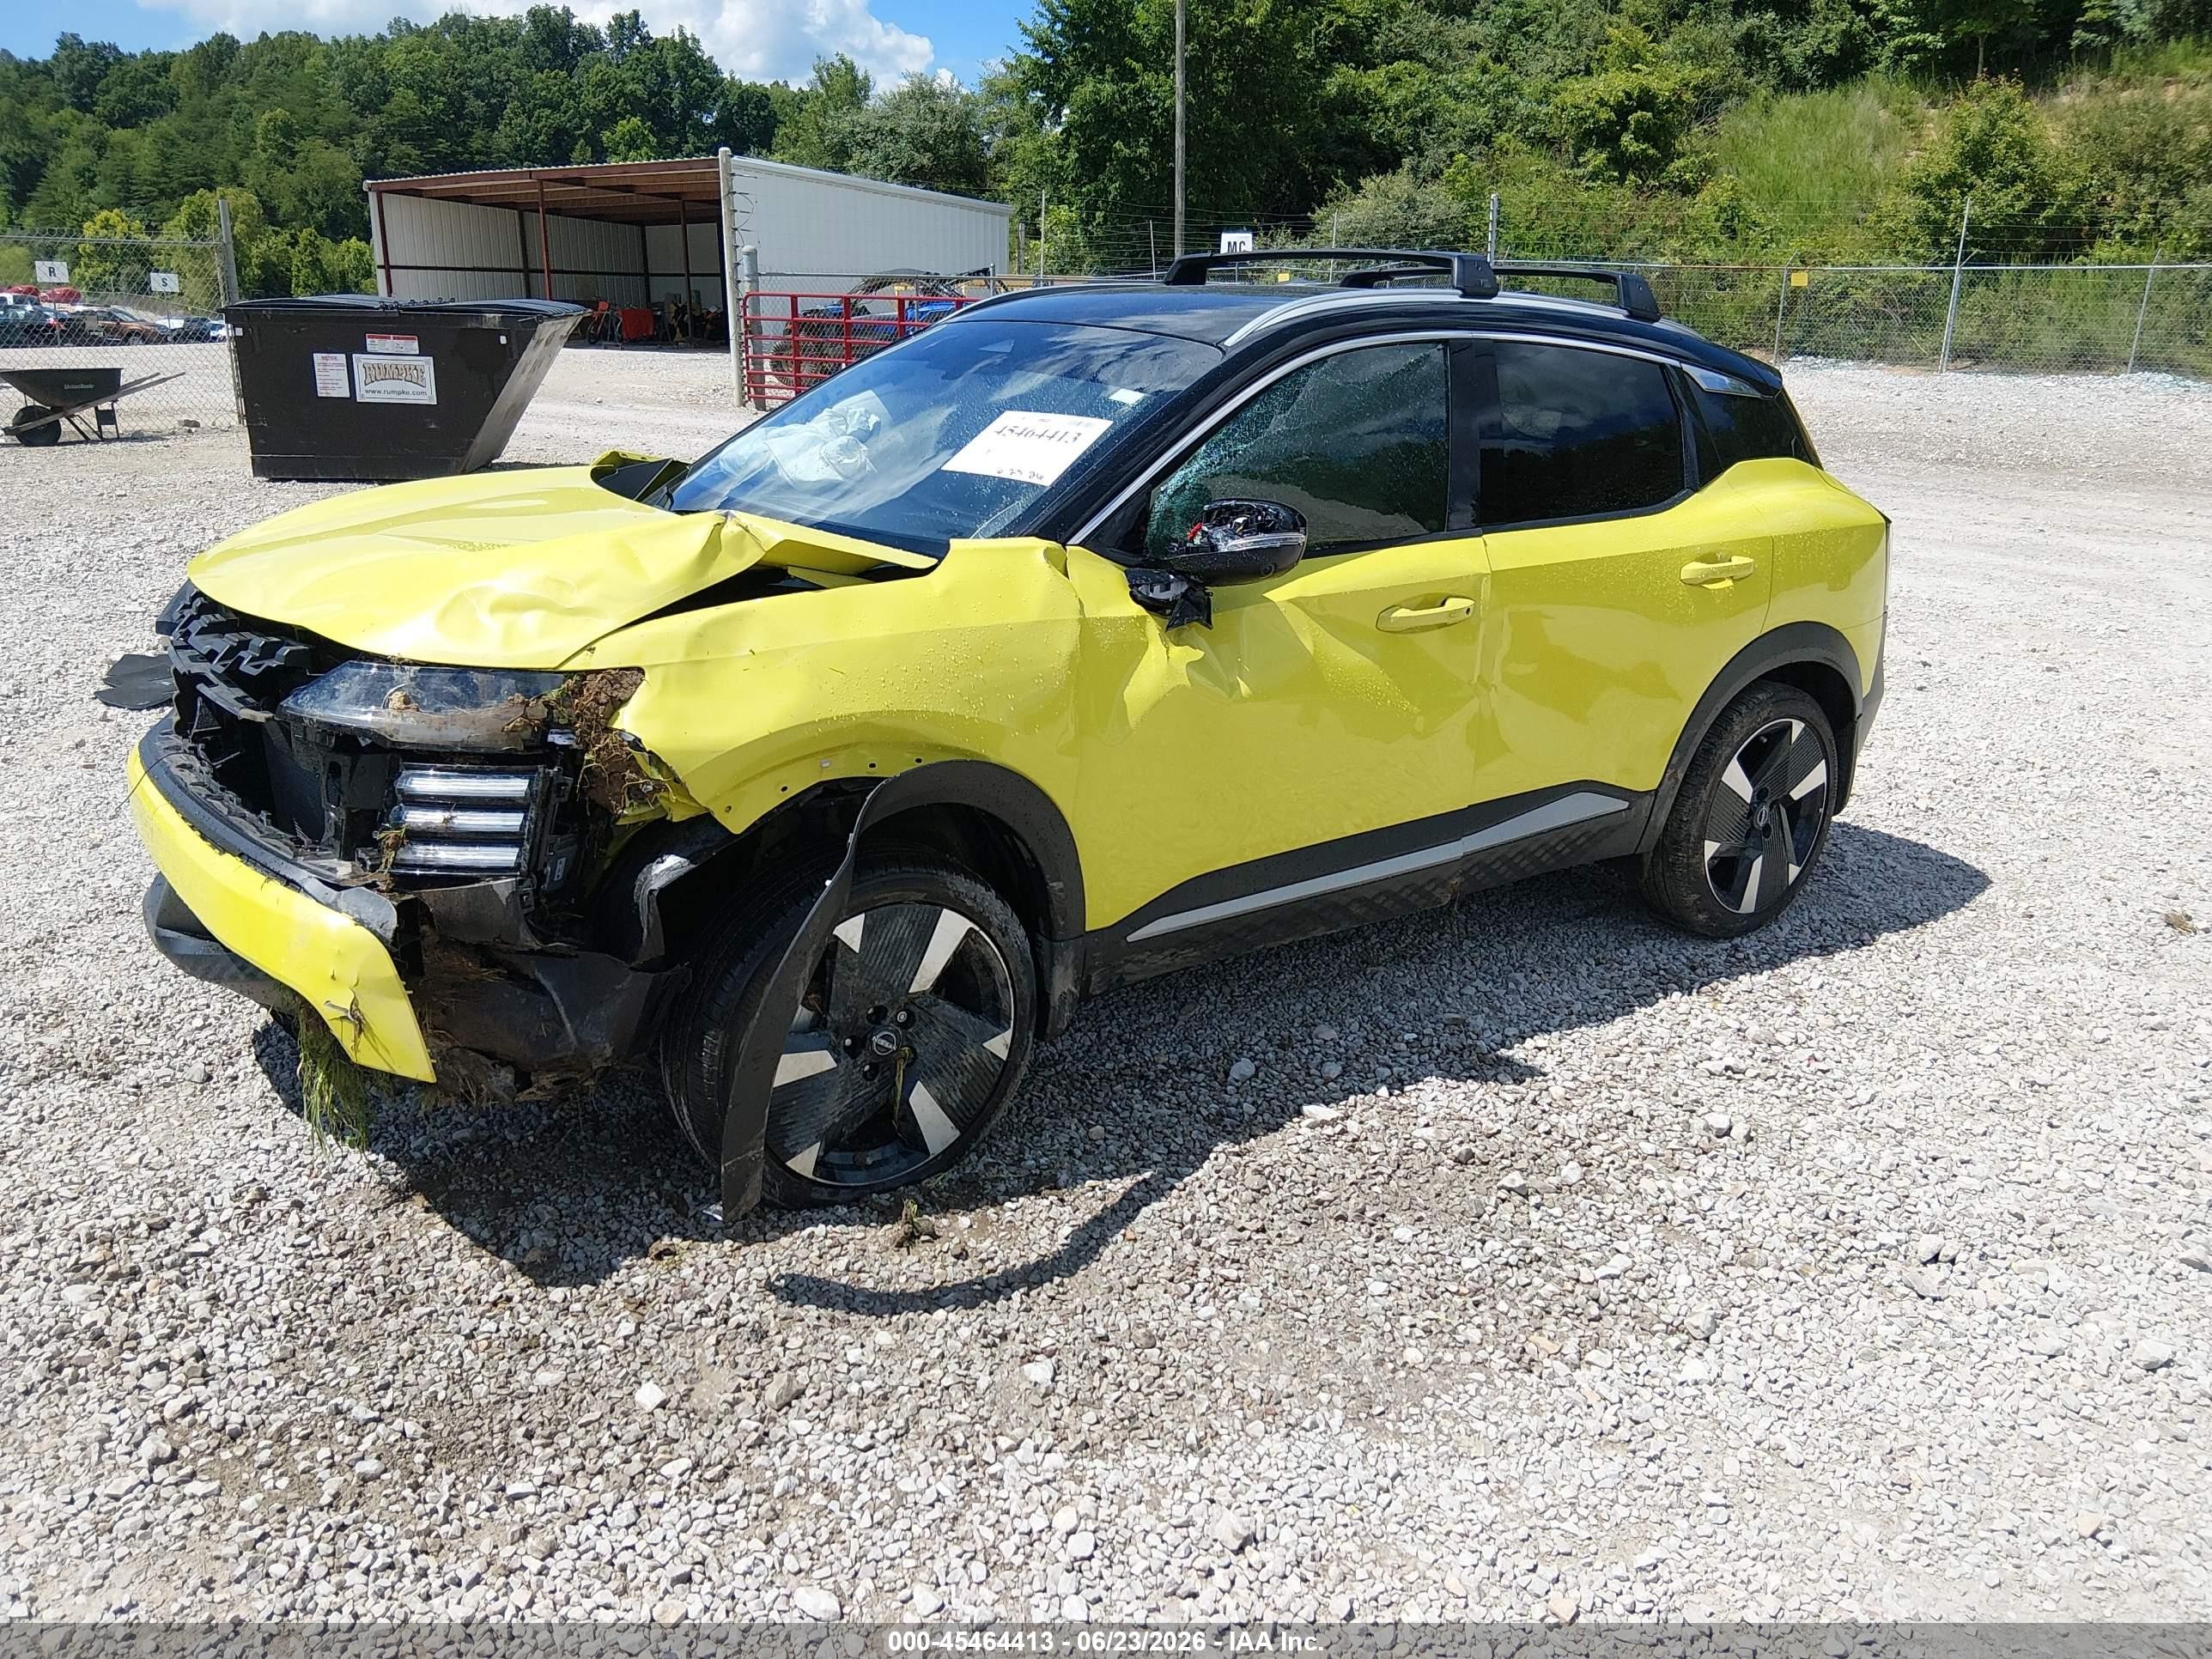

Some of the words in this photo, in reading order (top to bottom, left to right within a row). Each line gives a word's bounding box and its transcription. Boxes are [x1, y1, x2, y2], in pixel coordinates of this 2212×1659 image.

[1227, 240, 1246, 253] MC
[48, 266, 57, 277] R
[161, 277, 168, 288] S
[362, 362, 427, 388] RUMPKE
